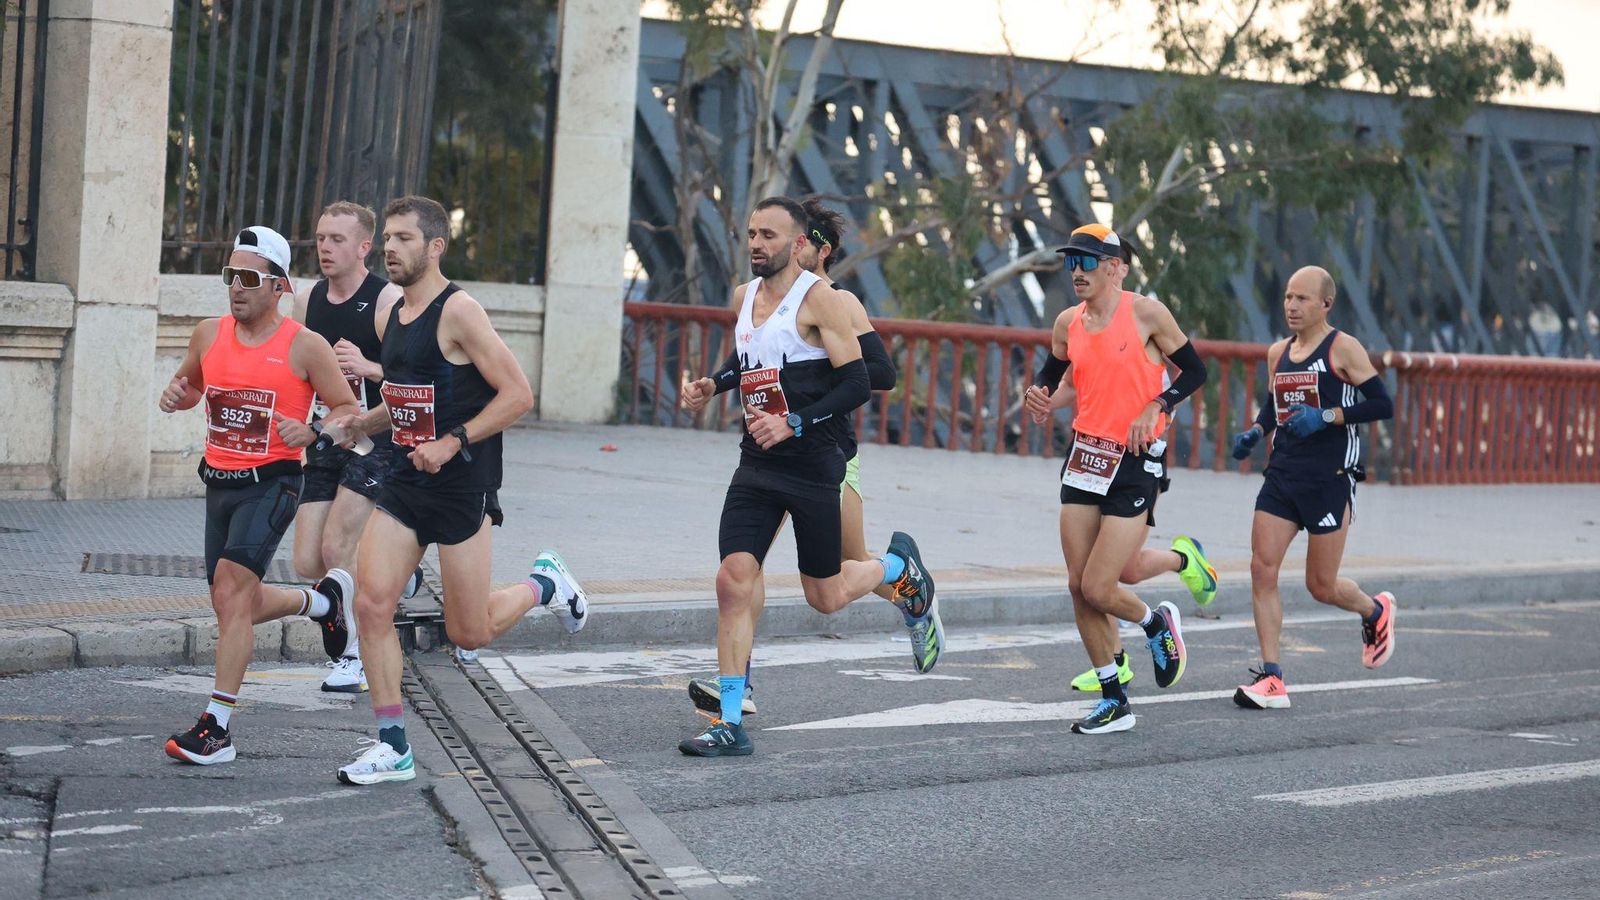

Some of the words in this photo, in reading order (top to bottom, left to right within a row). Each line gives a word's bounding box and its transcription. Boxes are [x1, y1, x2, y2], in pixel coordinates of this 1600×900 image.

[741, 371, 774, 385] GENERALI
[1283, 374, 1314, 384] GENERALI
[389, 386, 428, 399] GENERALI
[1283, 391, 1306, 402] 6256
[221, 407, 252, 424] 3523
[391, 406, 417, 422] 5673
[1164, 630, 1179, 660] HOKA
